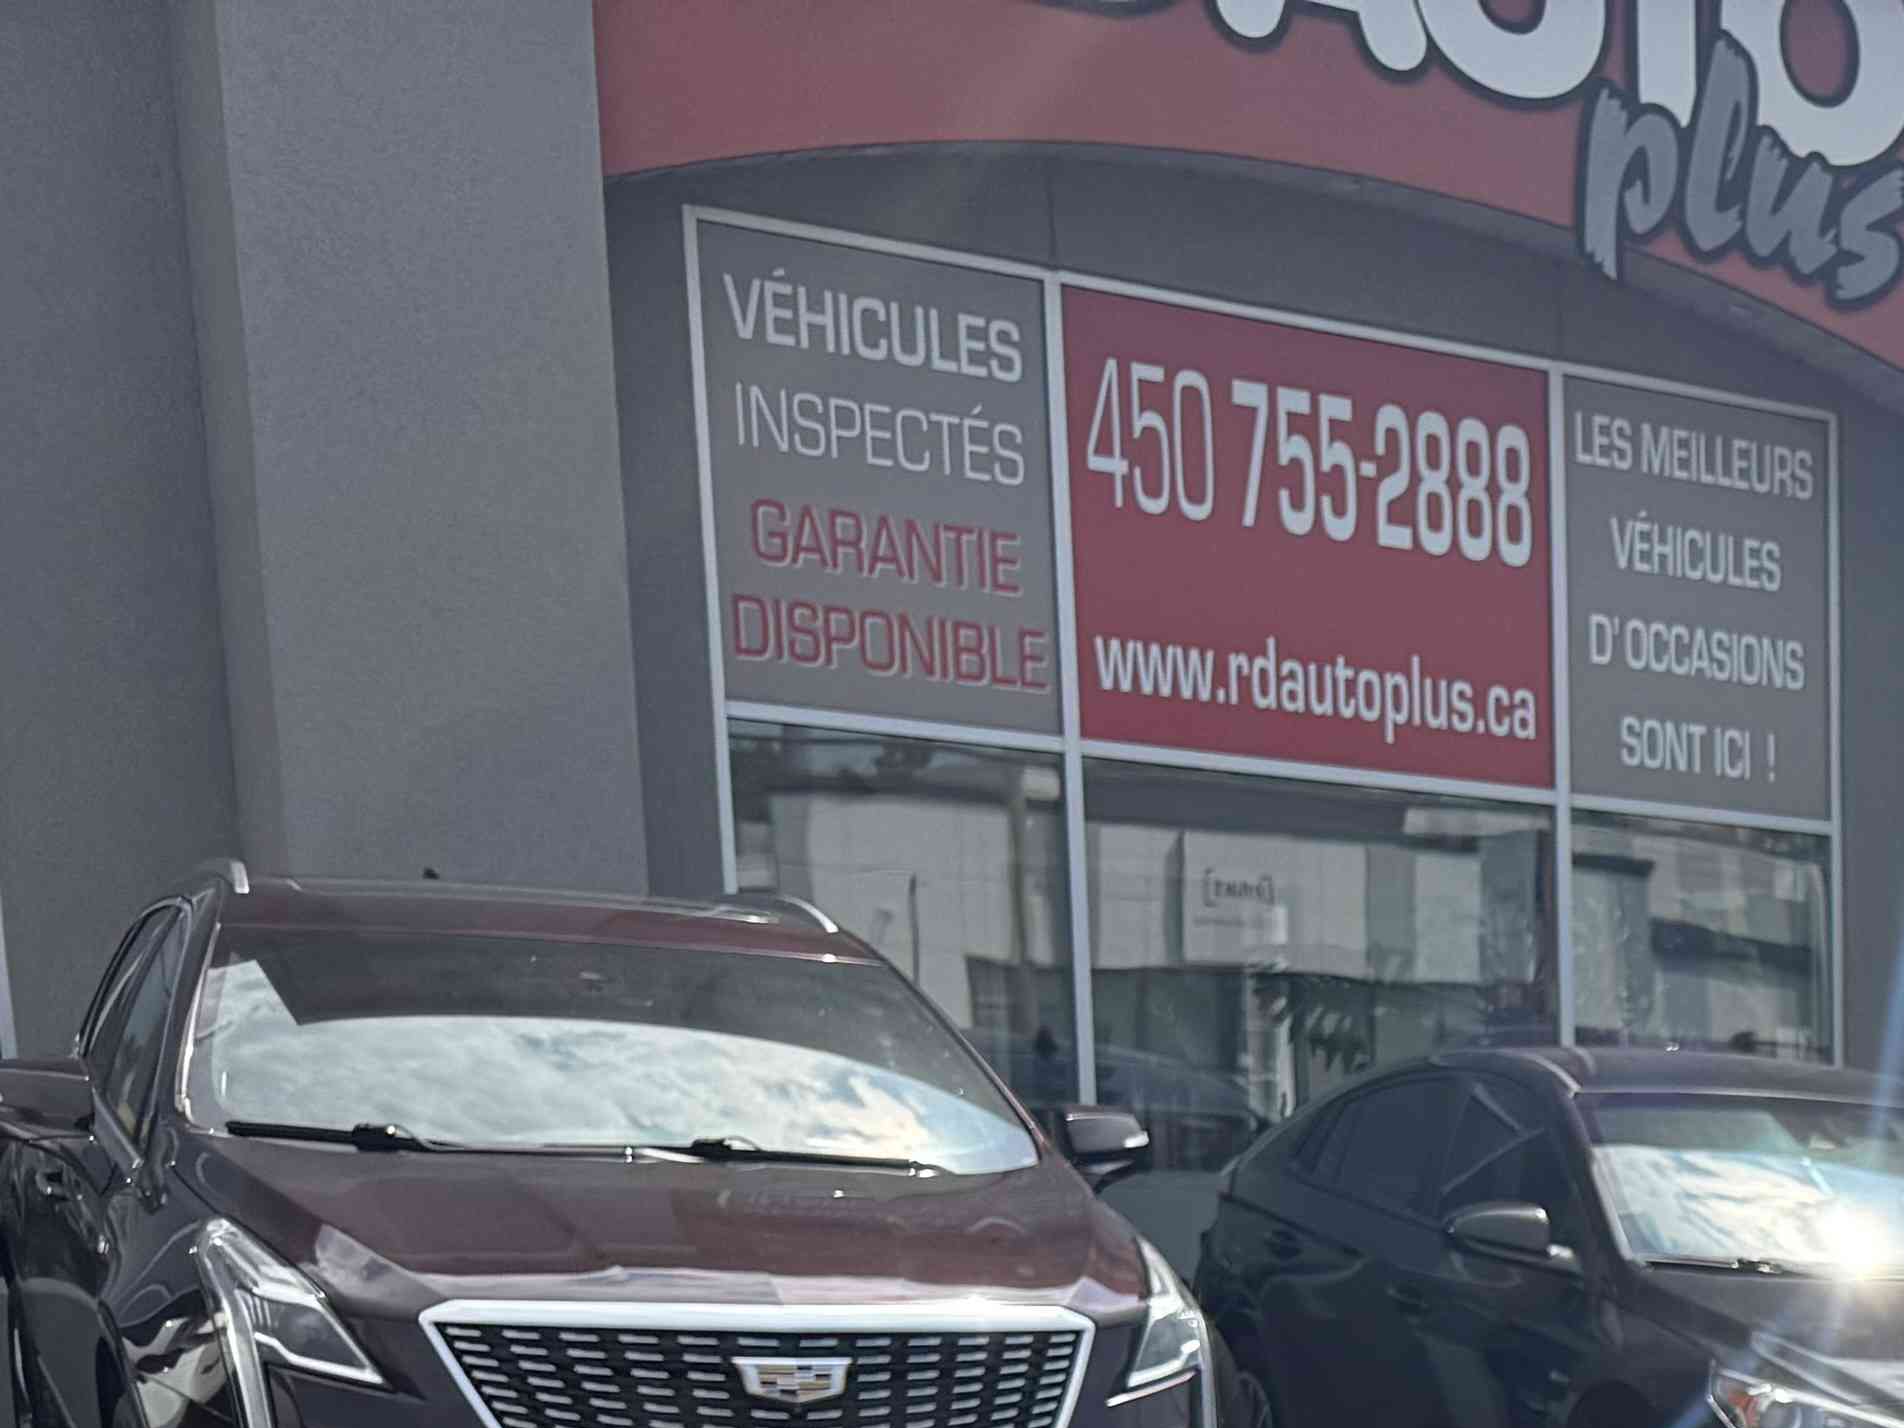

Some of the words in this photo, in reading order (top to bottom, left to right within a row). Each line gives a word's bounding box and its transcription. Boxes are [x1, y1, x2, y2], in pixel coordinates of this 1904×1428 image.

[722, 266, 1024, 383] VÉHICULES
[734, 381, 1026, 487] INSPECTÉS
[1086, 356, 1216, 522] 450
[1231, 378, 1533, 568] 755-2888
[1574, 410, 1633, 471] LES
[1640, 422, 1815, 500] MEILLEURS
[749, 498, 1024, 599] GARANTIE
[1609, 510, 1782, 592] VÉHICULES
[730, 592, 1052, 696] DISPONIBLE
[1093, 635, 1537, 745] www.rdautoplus.ca
[1620, 715, 1707, 775] SONT
[1714, 727, 1752, 781] ICI
[1766, 732, 1776, 783] !
